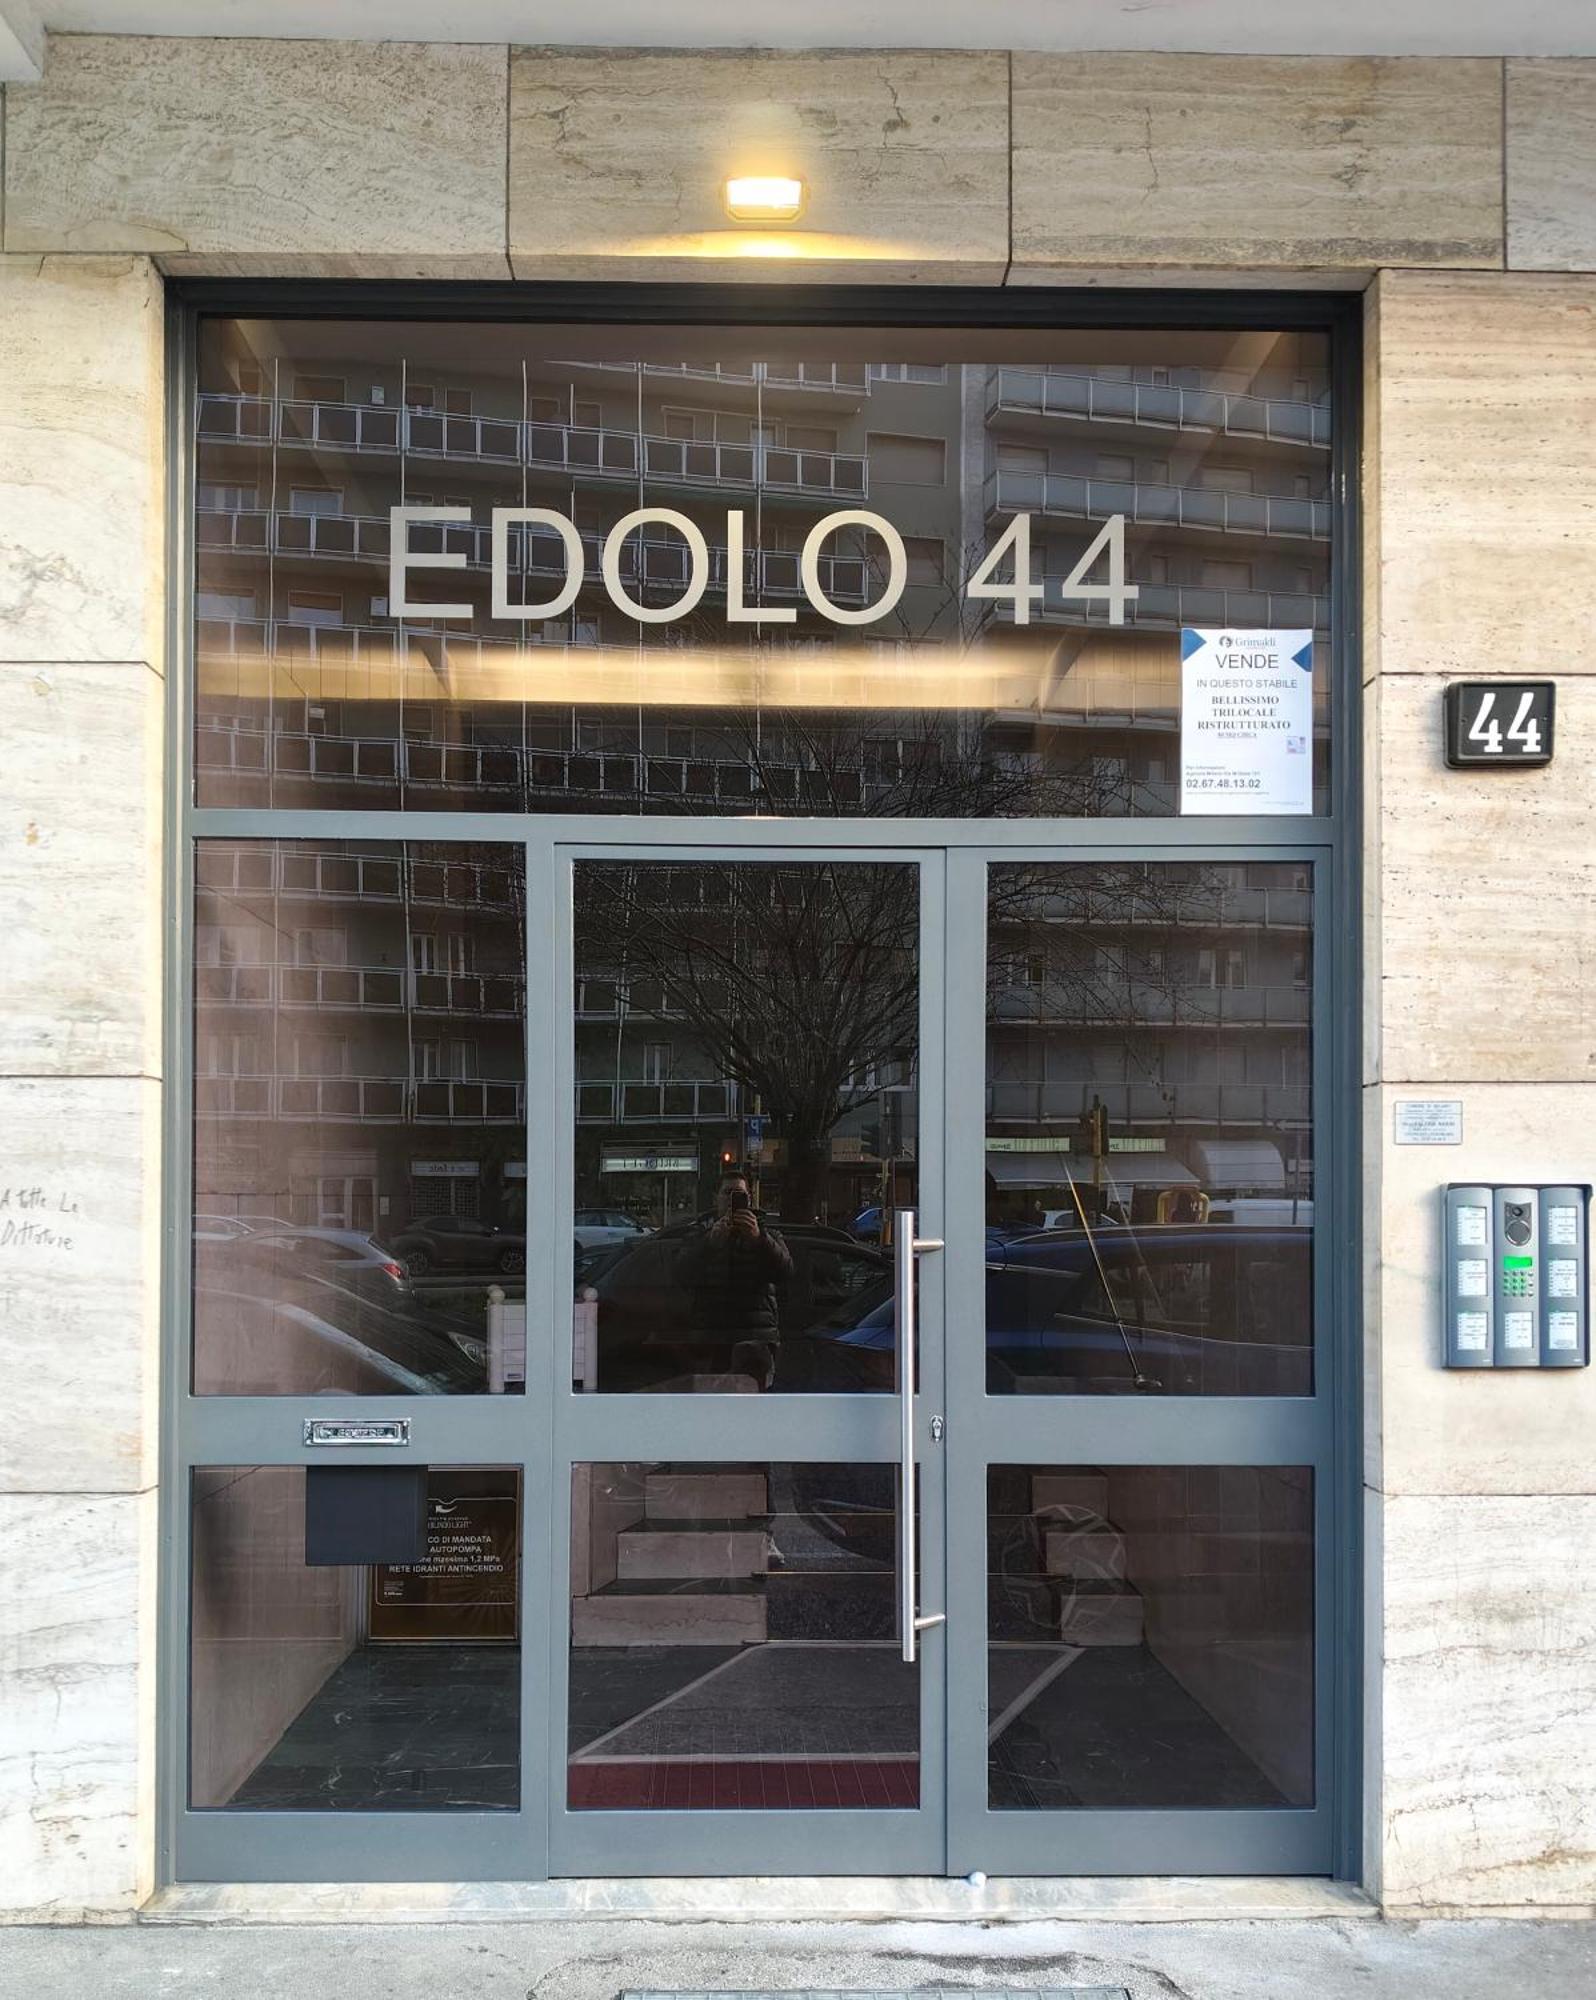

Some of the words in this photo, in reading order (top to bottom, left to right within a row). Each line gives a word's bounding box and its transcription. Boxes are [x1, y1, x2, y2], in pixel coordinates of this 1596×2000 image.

[390, 506, 908, 625] EDOLO
[967, 513, 1139, 625] 44
[1215, 654, 1279, 669] VENDE
[1197, 679, 1207, 688] IN
[1210, 679, 1253, 689] QUESTO
[1255, 679, 1297, 688] STABILE
[1211, 696, 1280, 705] BELLISSIMO
[1212, 708, 1277, 717] TRILOCALE
[1197, 720, 1291, 730] RISTRUTTURATO
[1468, 692, 1541, 753] 44
[1186, 778, 1261, 789] 02.67.48.13.02
[442, 1535, 450, 1543] DI
[452, 1535, 492, 1543] MANDATA
[389, 1565, 411, 1573] RETE
[447, 1564, 504, 1572] ANTINCENDIO
